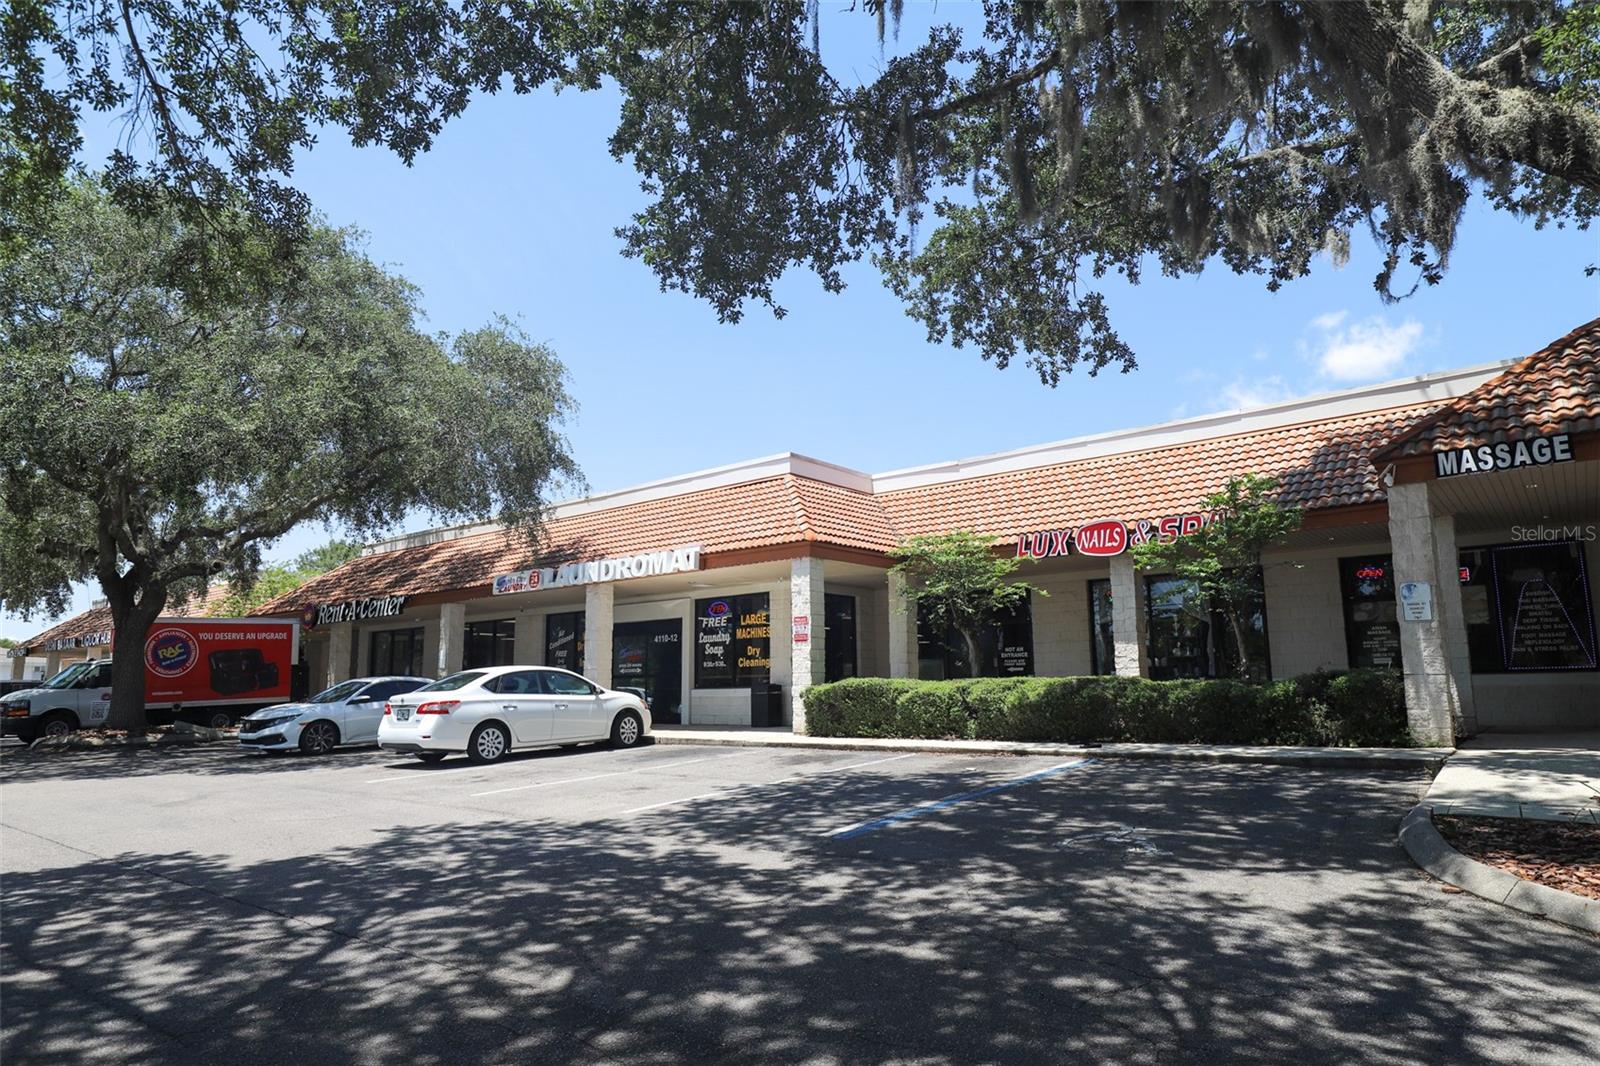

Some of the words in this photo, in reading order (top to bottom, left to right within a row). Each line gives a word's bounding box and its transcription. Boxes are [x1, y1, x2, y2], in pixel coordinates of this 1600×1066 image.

[1437, 435, 1572, 476] MASSAGE
[1017, 529, 1070, 558] LUX
[1080, 526, 1121, 549] NAILS
[1130, 519, 1151, 547] &
[543, 547, 699, 589] LAUNDROMAT
[1356, 568, 1384, 577] OPEN
[698, 616, 732, 628] FREE
[740, 612, 767, 625] LARGE
[199, 632, 213, 640] YOU
[214, 632, 245, 640] DESERVE
[246, 632, 256, 640] AN
[256, 632, 288, 640] UPGRADE
[654, 633, 678, 643] 4110-12
[699, 630, 731, 645] Laundry
[736, 627, 770, 640] MACHINES
[705, 643, 724, 657] Soap
[747, 646, 761, 657] Dry
[738, 657, 771, 669] Cleaning
